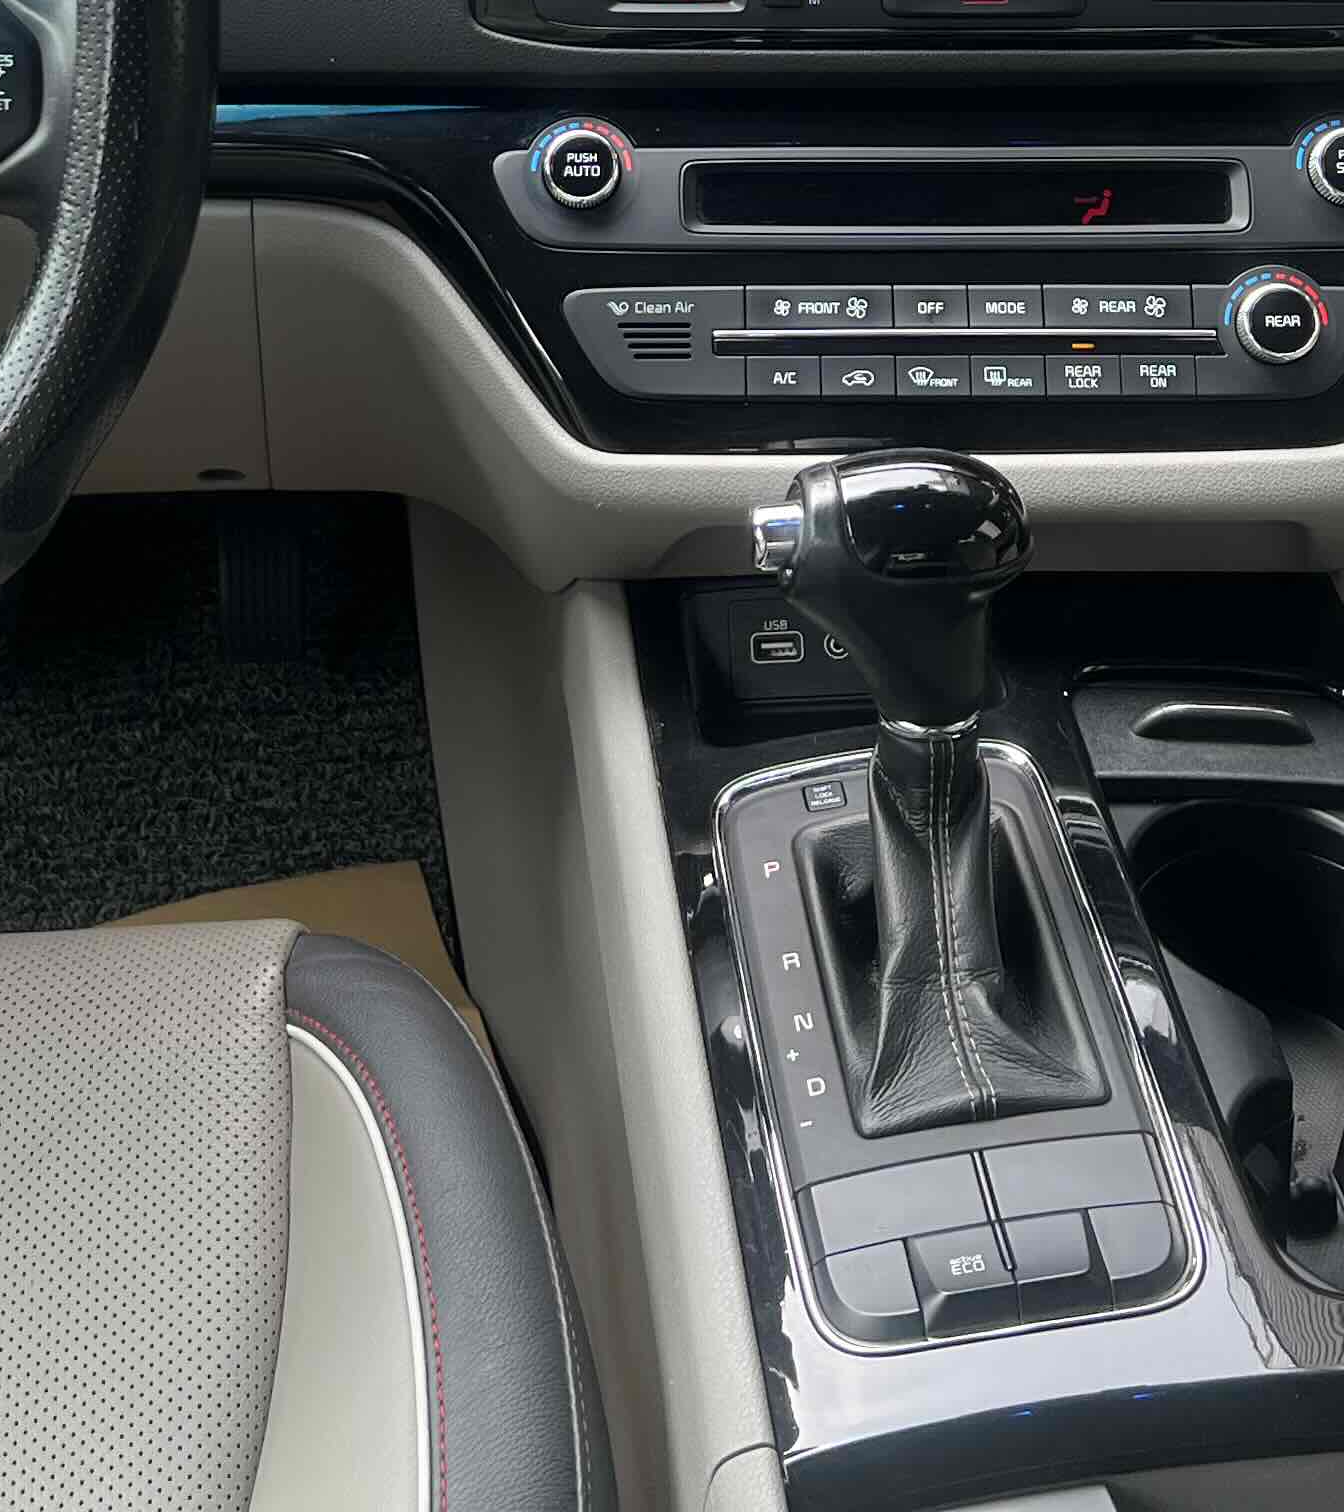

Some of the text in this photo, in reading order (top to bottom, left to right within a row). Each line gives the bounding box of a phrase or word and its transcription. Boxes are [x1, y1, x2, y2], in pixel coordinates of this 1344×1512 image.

[566, 152, 598, 163] PUSH
[563, 165, 601, 177] AUTO
[634, 300, 695, 314] Clean Air
[798, 301, 841, 315] FRONT
[917, 301, 945, 315] OFF
[985, 301, 1026, 315] MODE
[1099, 300, 1136, 313] REAR
[1264, 314, 1301, 328] REAR
[1064, 364, 1102, 377] REAR
[1139, 364, 1177, 377] REAR
[773, 371, 797, 385] A/C
[929, 377, 959, 388] FRONT
[1007, 378, 1033, 388] REAR
[1068, 377, 1098, 389] LOCK
[1150, 377, 1167, 389] ON
[763, 619, 789, 631] USB
[763, 861, 780, 879] P
[782, 952, 801, 971] R
[793, 1012, 814, 1032] N
[806, 1077, 826, 1097] D
[951, 1260, 985, 1276] ECO
